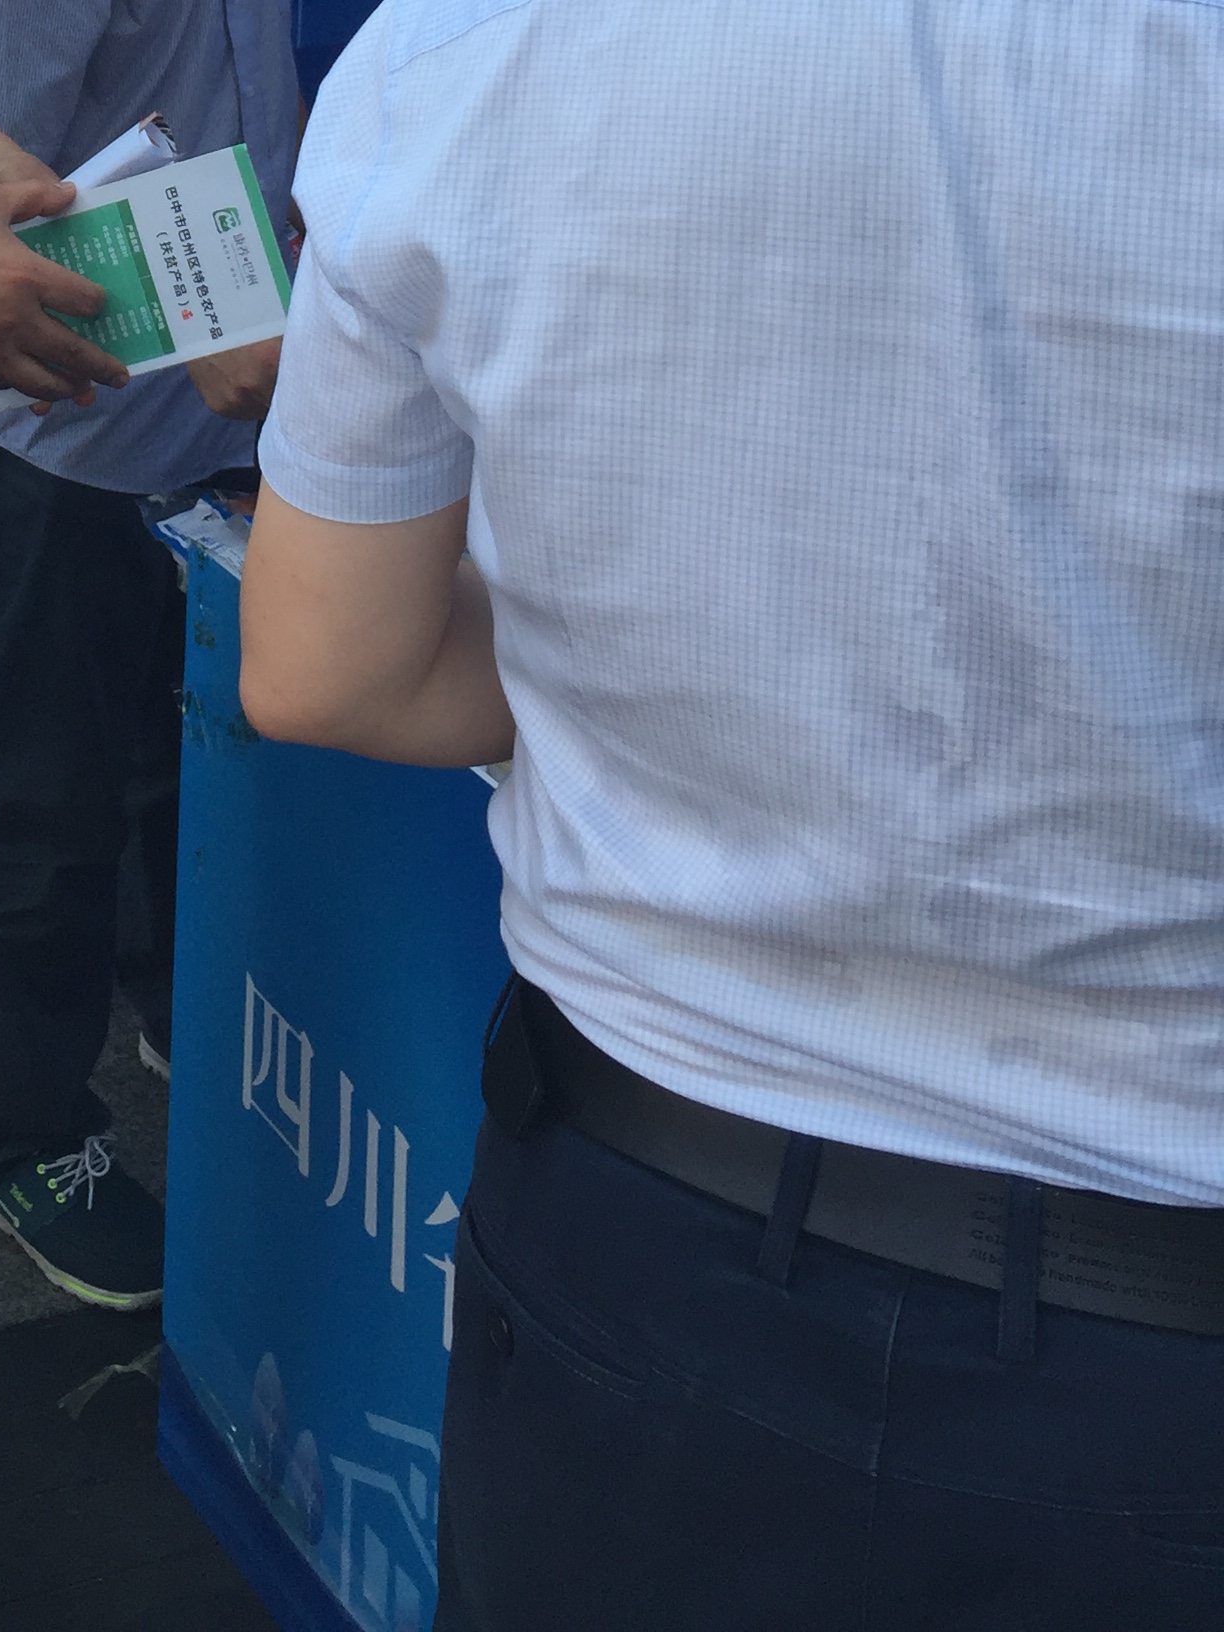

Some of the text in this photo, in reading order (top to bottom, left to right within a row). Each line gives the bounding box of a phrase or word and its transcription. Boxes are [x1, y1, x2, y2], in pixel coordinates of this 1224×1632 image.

[165, 186, 223, 340] 巴中市巴州区特色农产品
